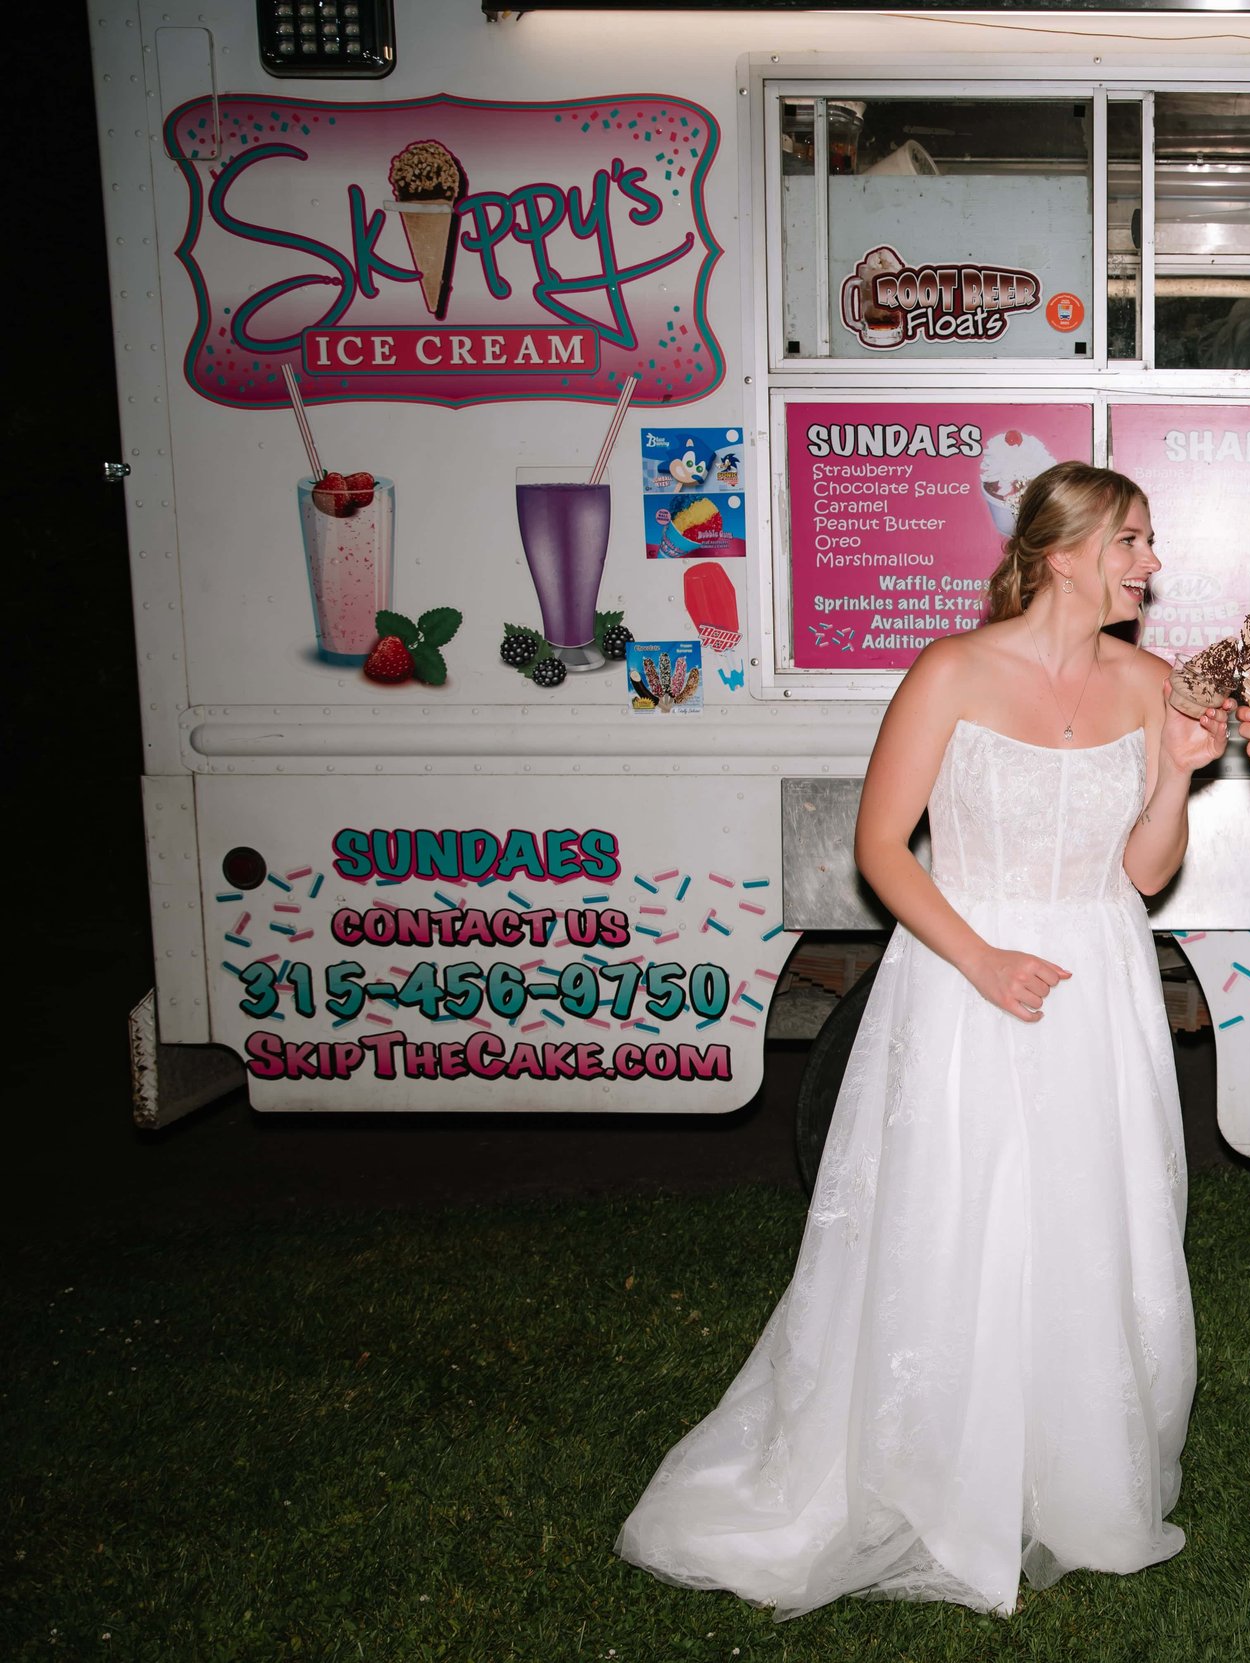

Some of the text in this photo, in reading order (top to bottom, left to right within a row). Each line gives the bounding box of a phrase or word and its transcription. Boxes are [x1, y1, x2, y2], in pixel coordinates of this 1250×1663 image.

[877, 269, 1036, 312] ROOT BEER
[907, 307, 1003, 336] Floats
[317, 335, 586, 366] ICE CREAM
[807, 423, 983, 458] SUNDAES
[812, 463, 913, 480] Strawberry
[813, 481, 970, 498] Chocolate Sauce
[814, 499, 888, 514] Caramel
[813, 516, 946, 532] Peanut Butter
[815, 535, 861, 550] Oreo
[816, 552, 934, 568] Marshmallow
[879, 575, 990, 591] Waffle Cones
[814, 594, 982, 613] Sprinkles and Extra
[871, 614, 980, 630] Available for
[701, 637, 737, 652] POP
[332, 828, 621, 883] SUNDAES
[331, 908, 631, 947] CONTACT US
[238, 960, 730, 1021] 315-456-9750
